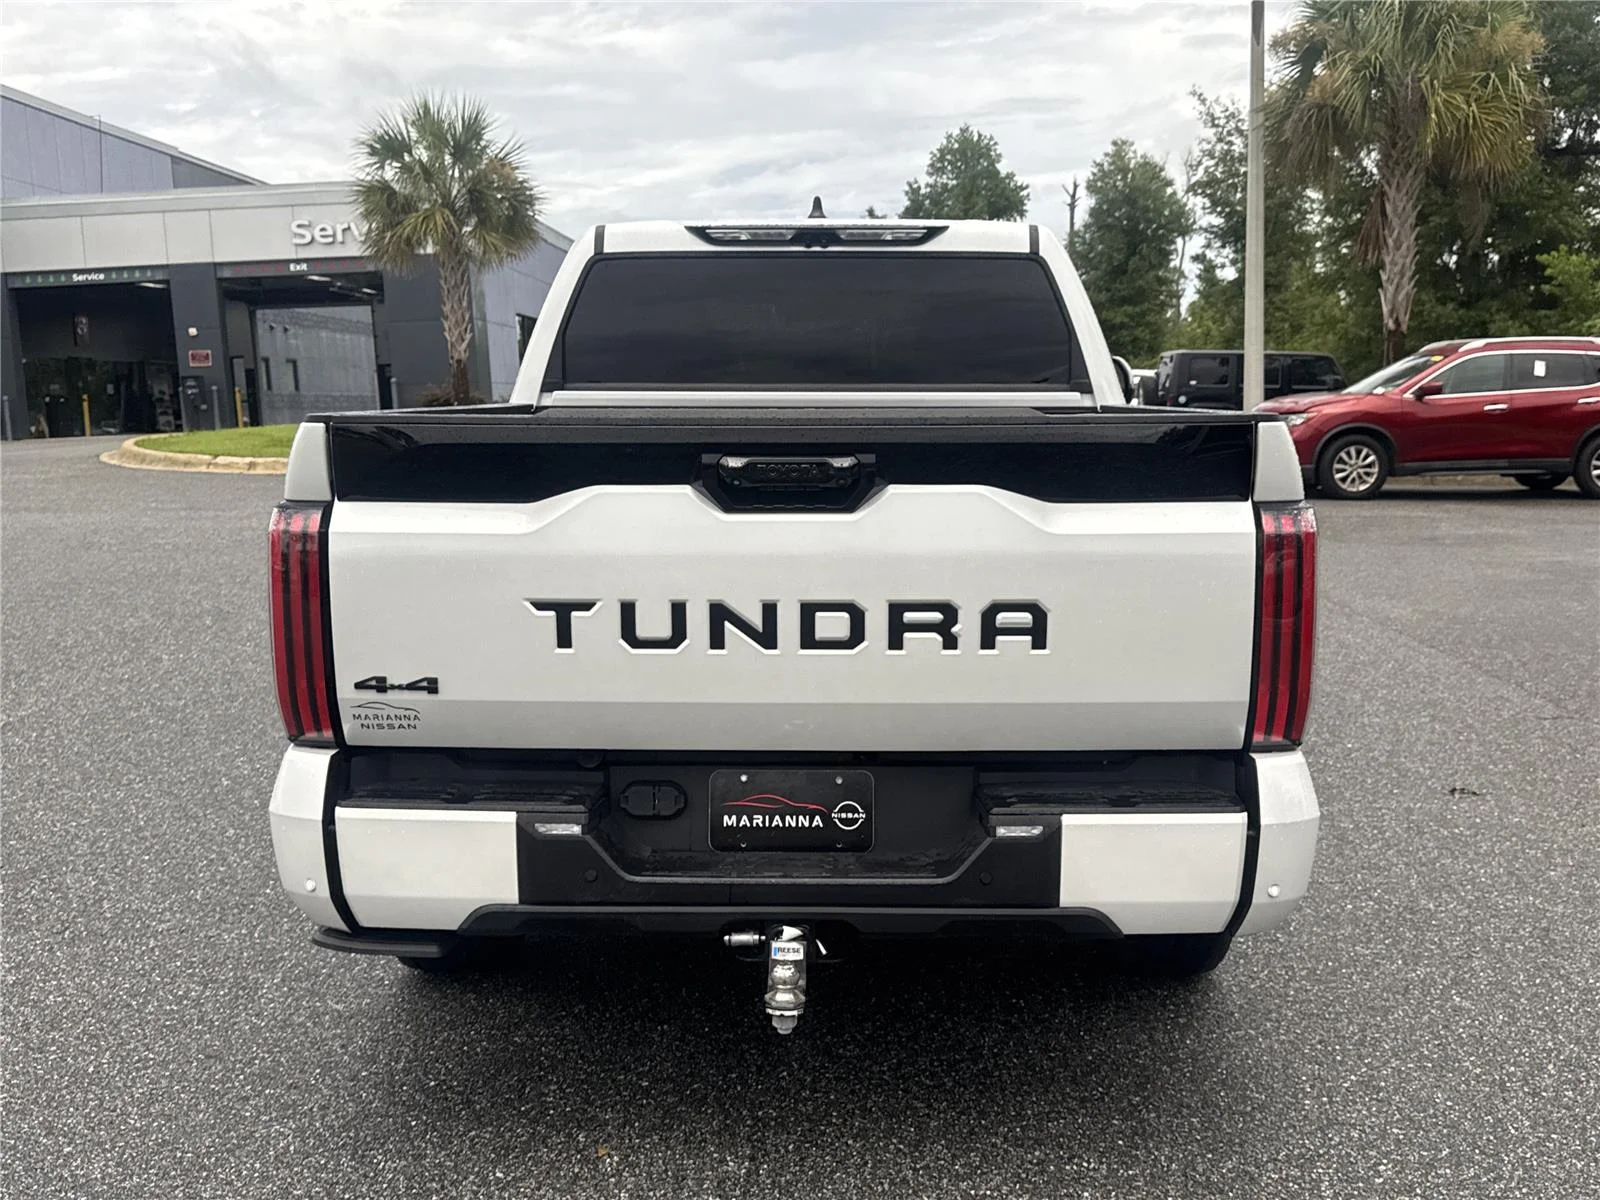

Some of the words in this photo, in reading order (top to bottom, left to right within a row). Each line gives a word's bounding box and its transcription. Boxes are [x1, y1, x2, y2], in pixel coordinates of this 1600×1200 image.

[290, 219, 370, 245] Serv
[289, 262, 308, 271] Exit
[72, 271, 105, 282] Service
[756, 464, 819, 478] TOYOTA
[523, 598, 1050, 656] TUNDRA
[352, 713, 421, 721] MARIANNA
[360, 722, 417, 730] NISSAN
[723, 814, 824, 828] MARIANNA
[777, 946, 801, 954] REESE
